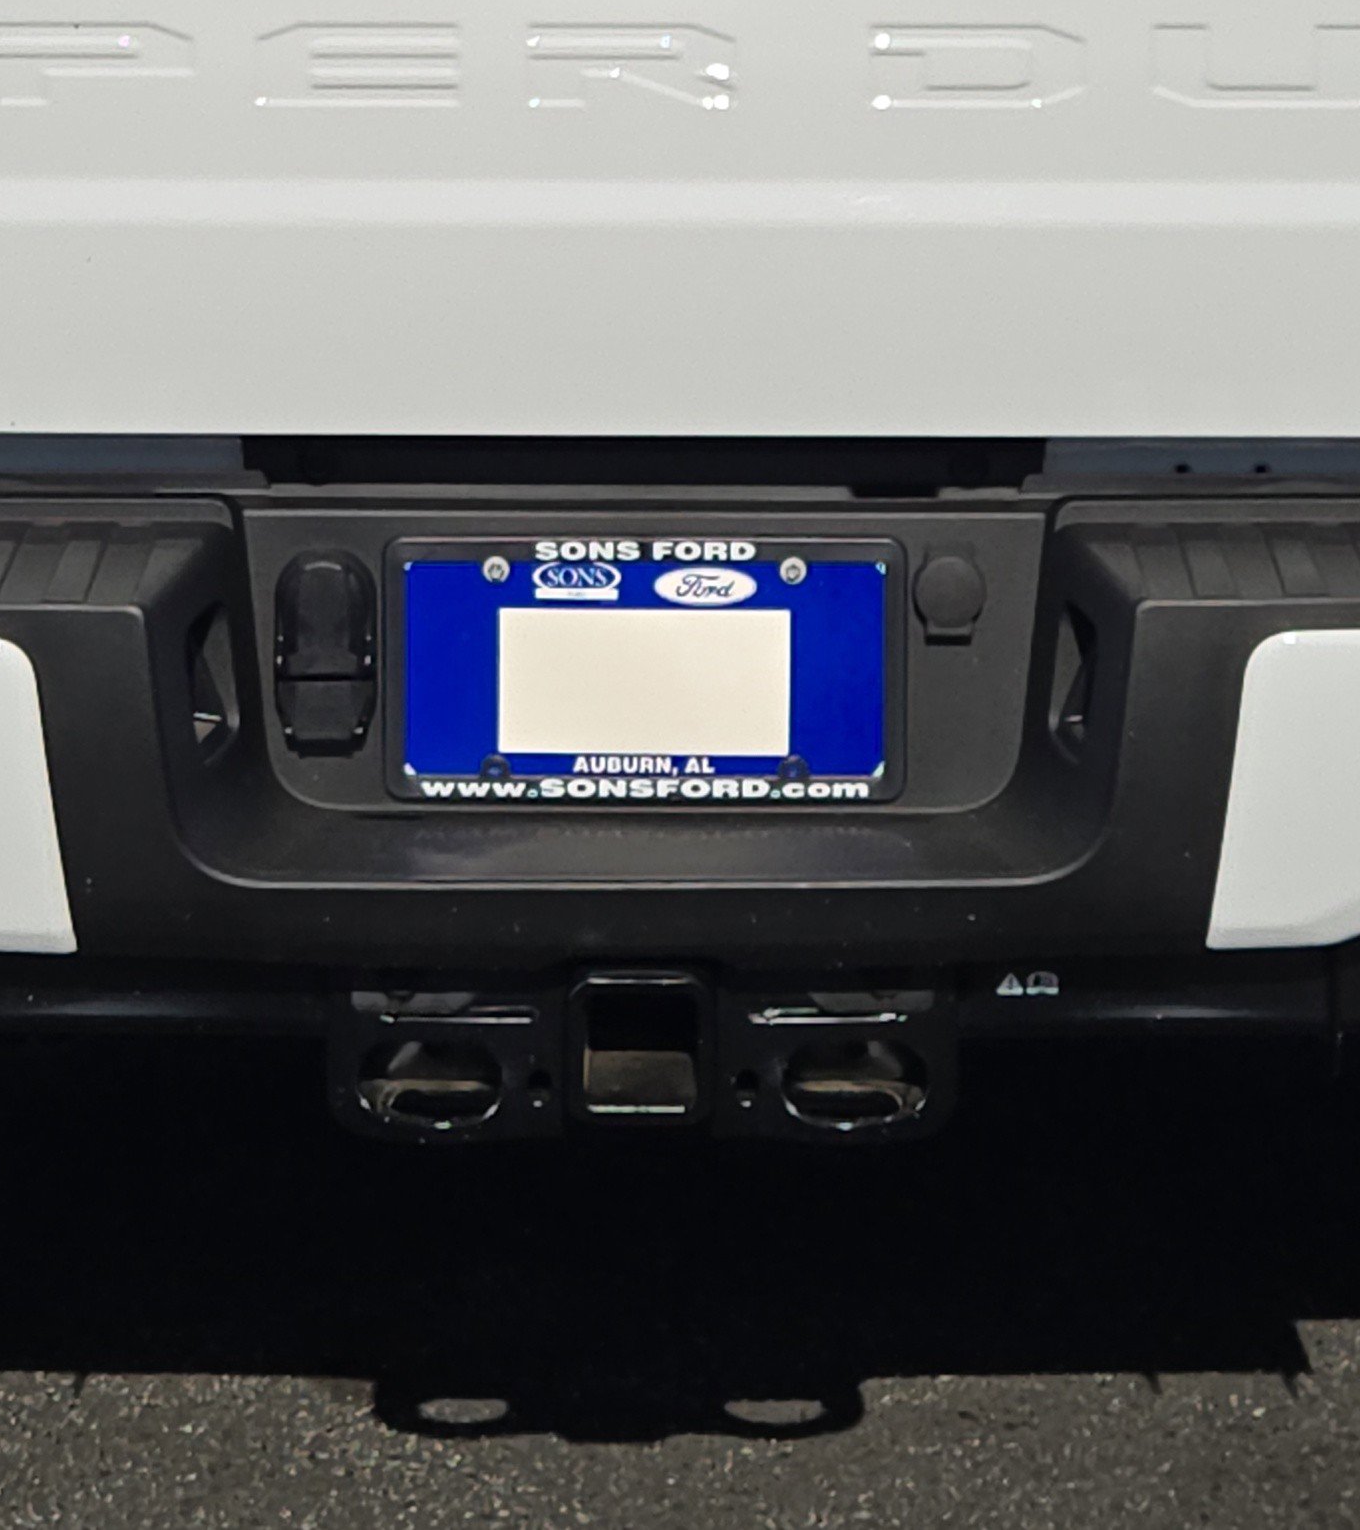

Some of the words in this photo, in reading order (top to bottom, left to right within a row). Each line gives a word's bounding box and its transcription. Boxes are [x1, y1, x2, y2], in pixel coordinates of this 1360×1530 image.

[534, 540, 641, 562] SONS
[651, 540, 757, 562] FORD
[545, 566, 609, 588] SONS
[675, 573, 736, 599] Ford
[572, 756, 679, 776] AUBURN,
[684, 757, 716, 774] AL
[420, 777, 870, 799] www.SONSFORD.com
